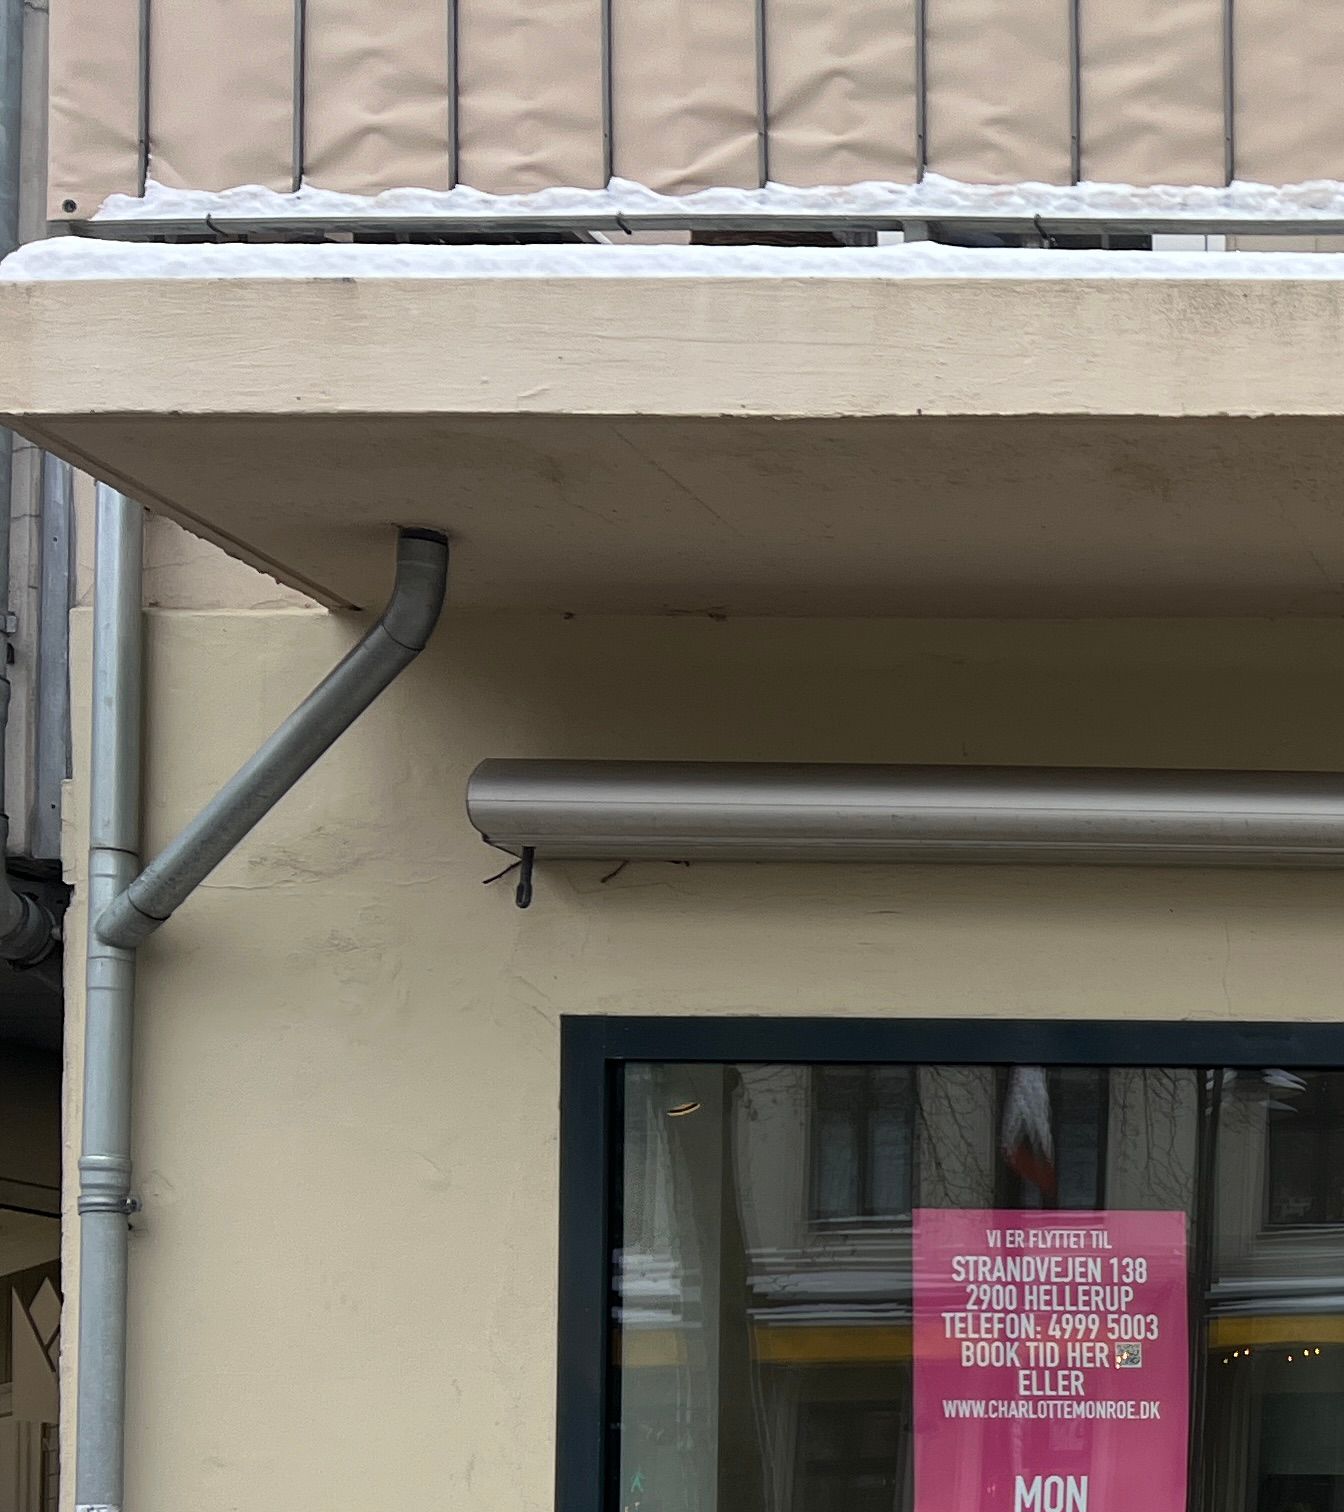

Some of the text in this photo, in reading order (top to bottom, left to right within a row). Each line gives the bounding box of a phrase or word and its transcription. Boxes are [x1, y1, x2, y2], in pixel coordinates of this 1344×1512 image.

[986, 1229, 1113, 1249] VI ER FLYTTET TIL
[951, 1255, 1147, 1286] STRANDVEJEN 138
[966, 1283, 1134, 1314] 2900 HELLERUP
[941, 1312, 1159, 1340] TELEFON: 4999 5003
[961, 1341, 1110, 1368] BOOK TID HER
[1018, 1369, 1085, 1396] ELLER
[943, 1399, 1161, 1420] WWW.CHARLOTTEMONROE.DK
